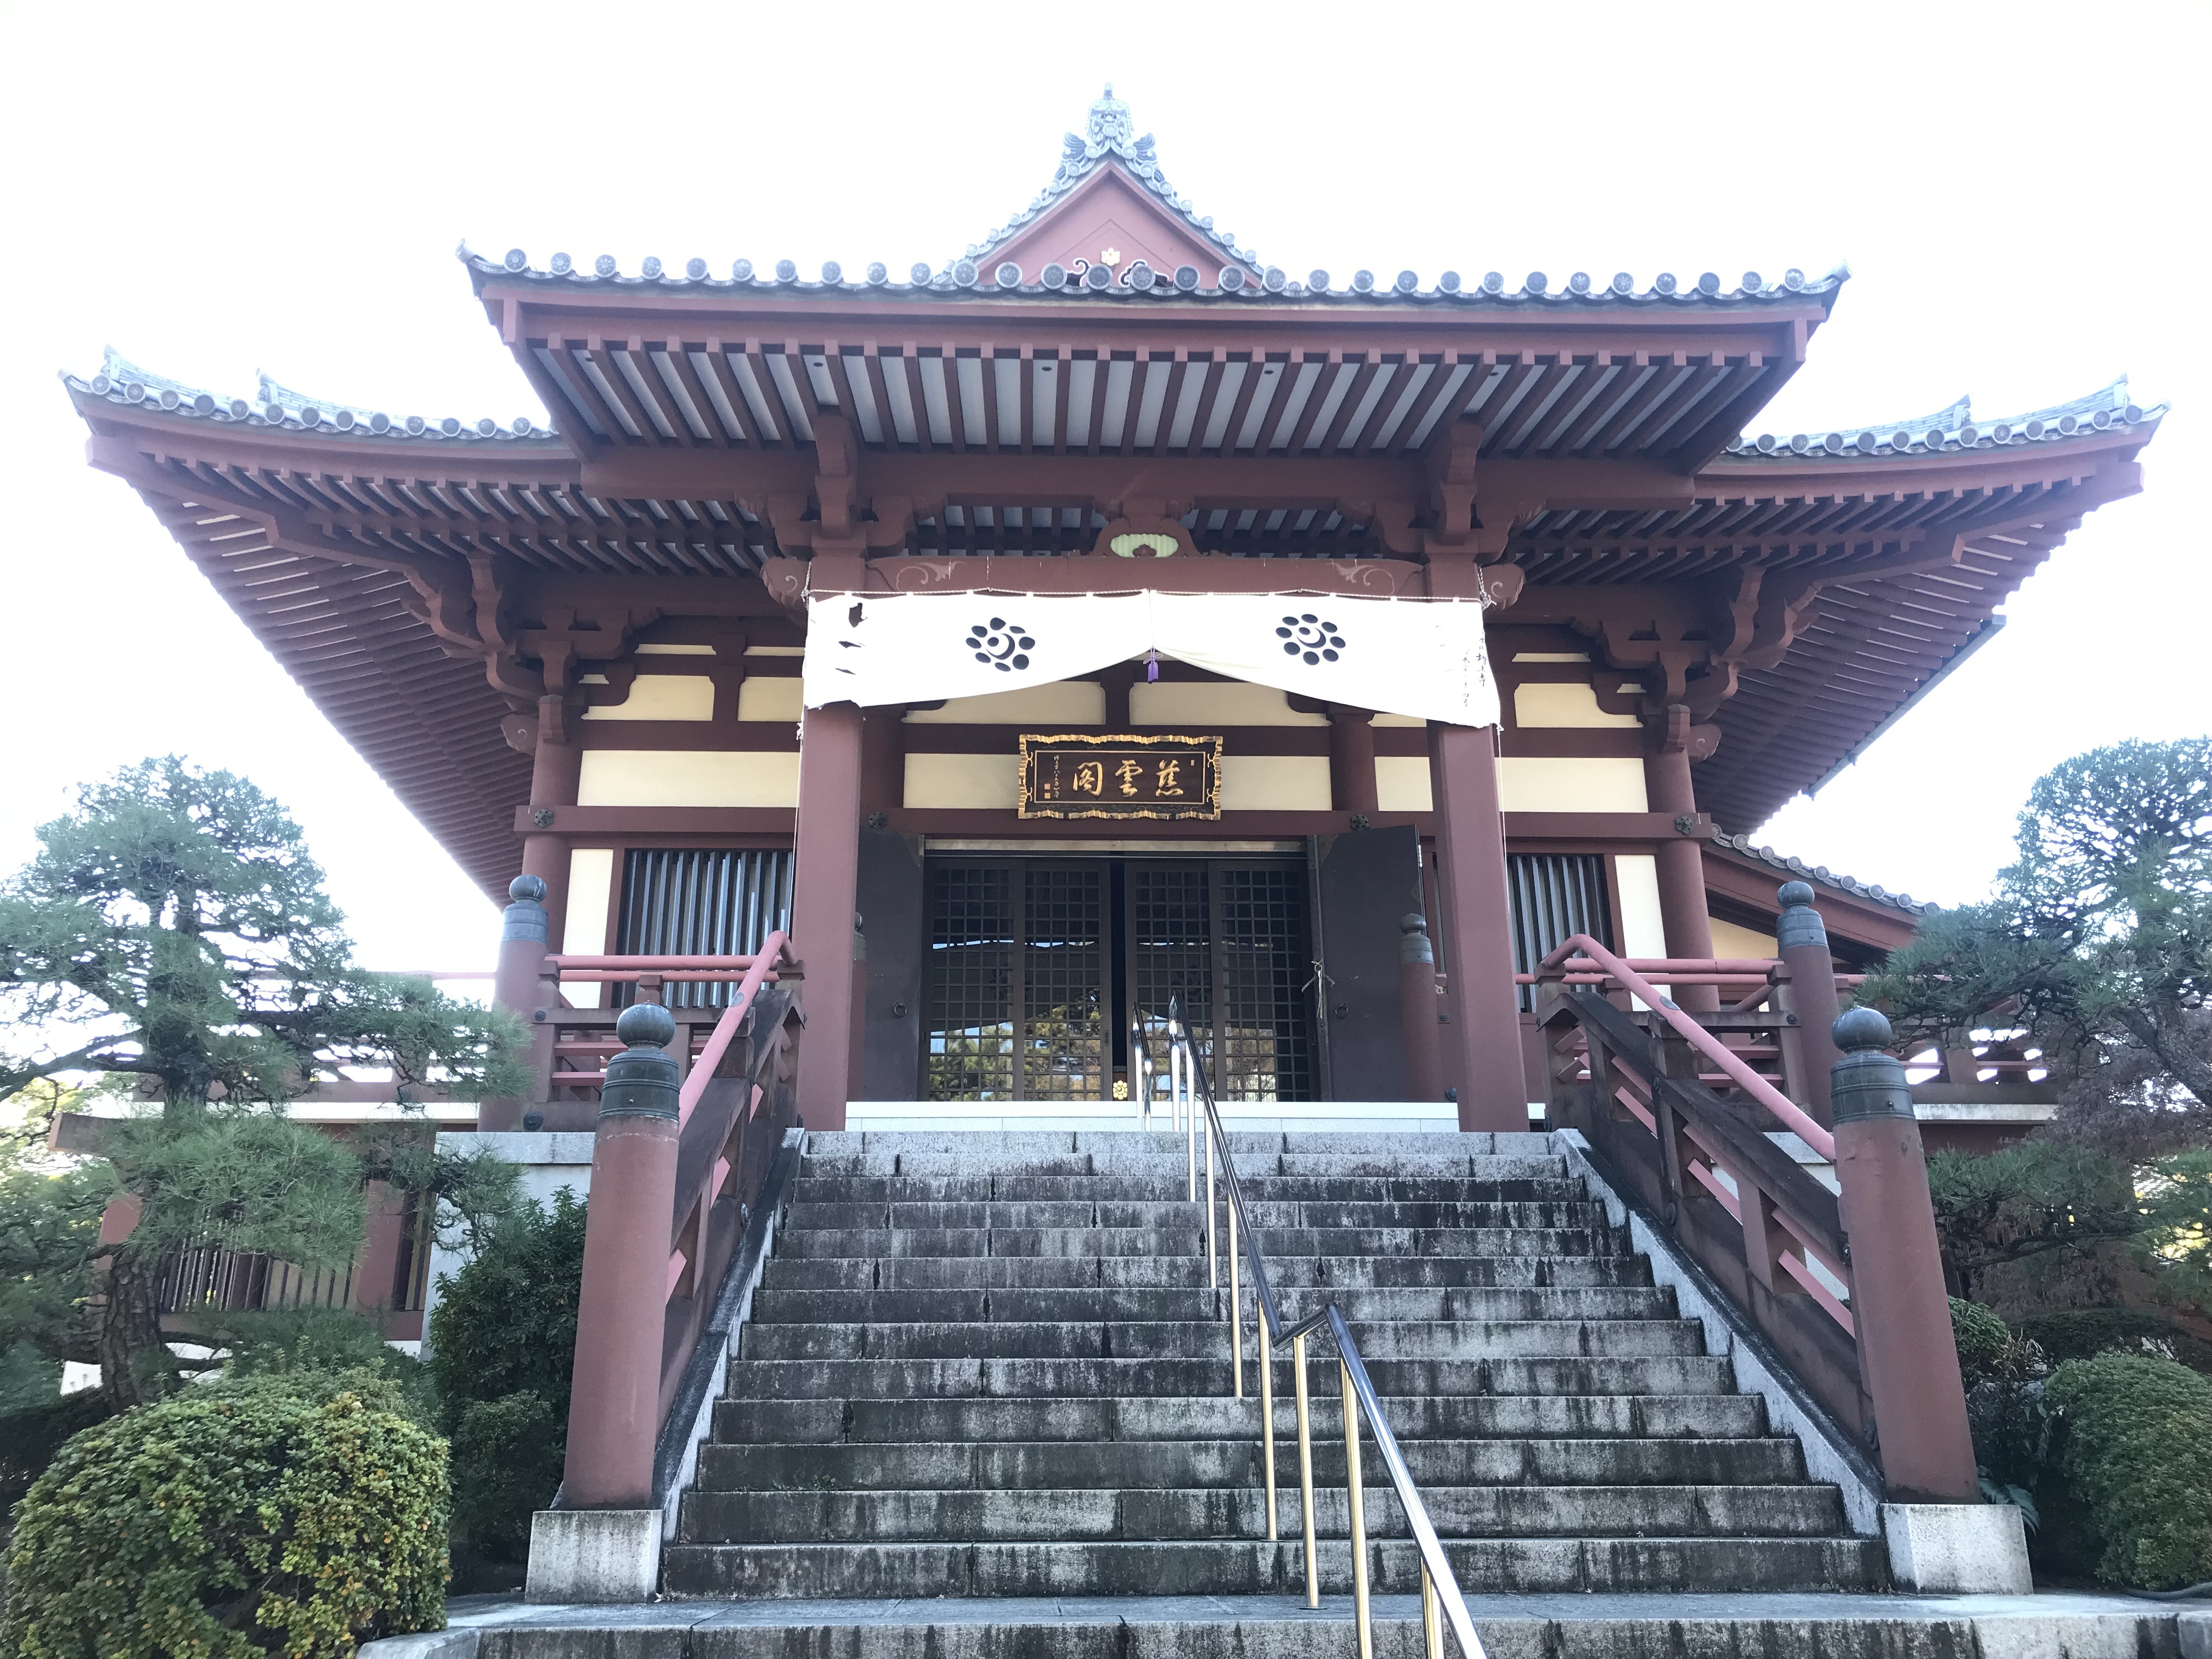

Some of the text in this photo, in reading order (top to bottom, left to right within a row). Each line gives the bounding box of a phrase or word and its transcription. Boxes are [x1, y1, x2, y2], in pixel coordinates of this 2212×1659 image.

[1476, 631, 1487, 687] 本山増上寺
